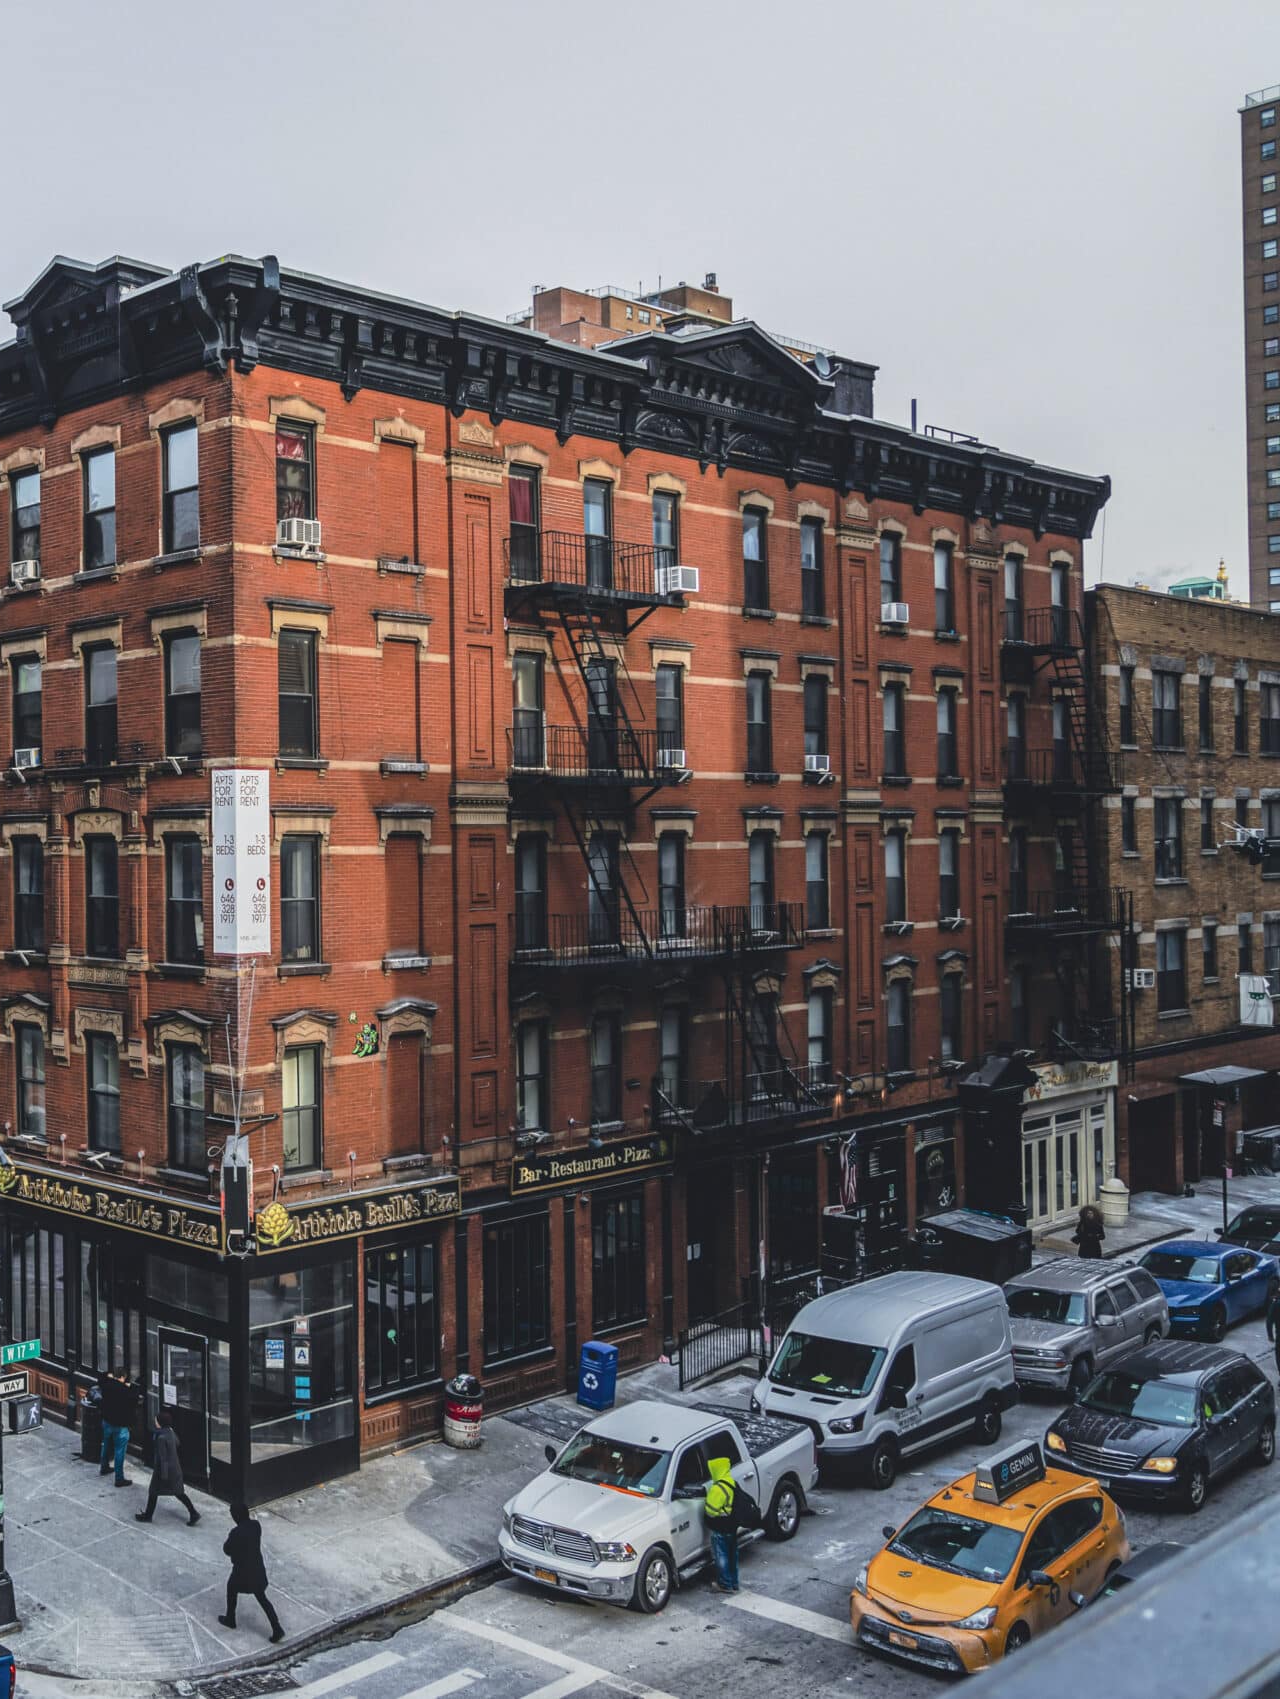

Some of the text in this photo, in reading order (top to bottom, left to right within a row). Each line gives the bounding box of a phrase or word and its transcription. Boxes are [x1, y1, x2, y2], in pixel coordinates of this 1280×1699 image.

[214, 776, 233, 785] APTS
[240, 776, 259, 785] APTS
[214, 786, 230, 796] FOR
[240, 786, 256, 796] FOR
[214, 797, 234, 807] RENT
[240, 797, 260, 807] RENT
[224, 834, 235, 844] 1-3
[255, 834, 265, 844] 1-3
[216, 845, 235, 855] BEDS
[247, 845, 265, 855] BEDS
[221, 894, 235, 903] 646
[252, 894, 266, 903] 646
[222, 904, 235, 913] 328
[253, 904, 266, 913] 328
[220, 914, 235, 924] 1917
[251, 914, 266, 924] 1917
[518, 1147, 651, 1184] Bar Restaurant Pizz
[17, 1174, 92, 1213] Artichoke
[167, 1209, 219, 1246] Pizza
[291, 1205, 363, 1242] Artichoke
[422, 1188, 460, 1215] Pizza
[7, 1348, 15, 1360] W
[17, 1345, 26, 1359] 17
[297, 1350, 306, 1359] A
[4, 1380, 20, 1392] WAY
[1009, 1452, 1034, 1474] GEMINI
